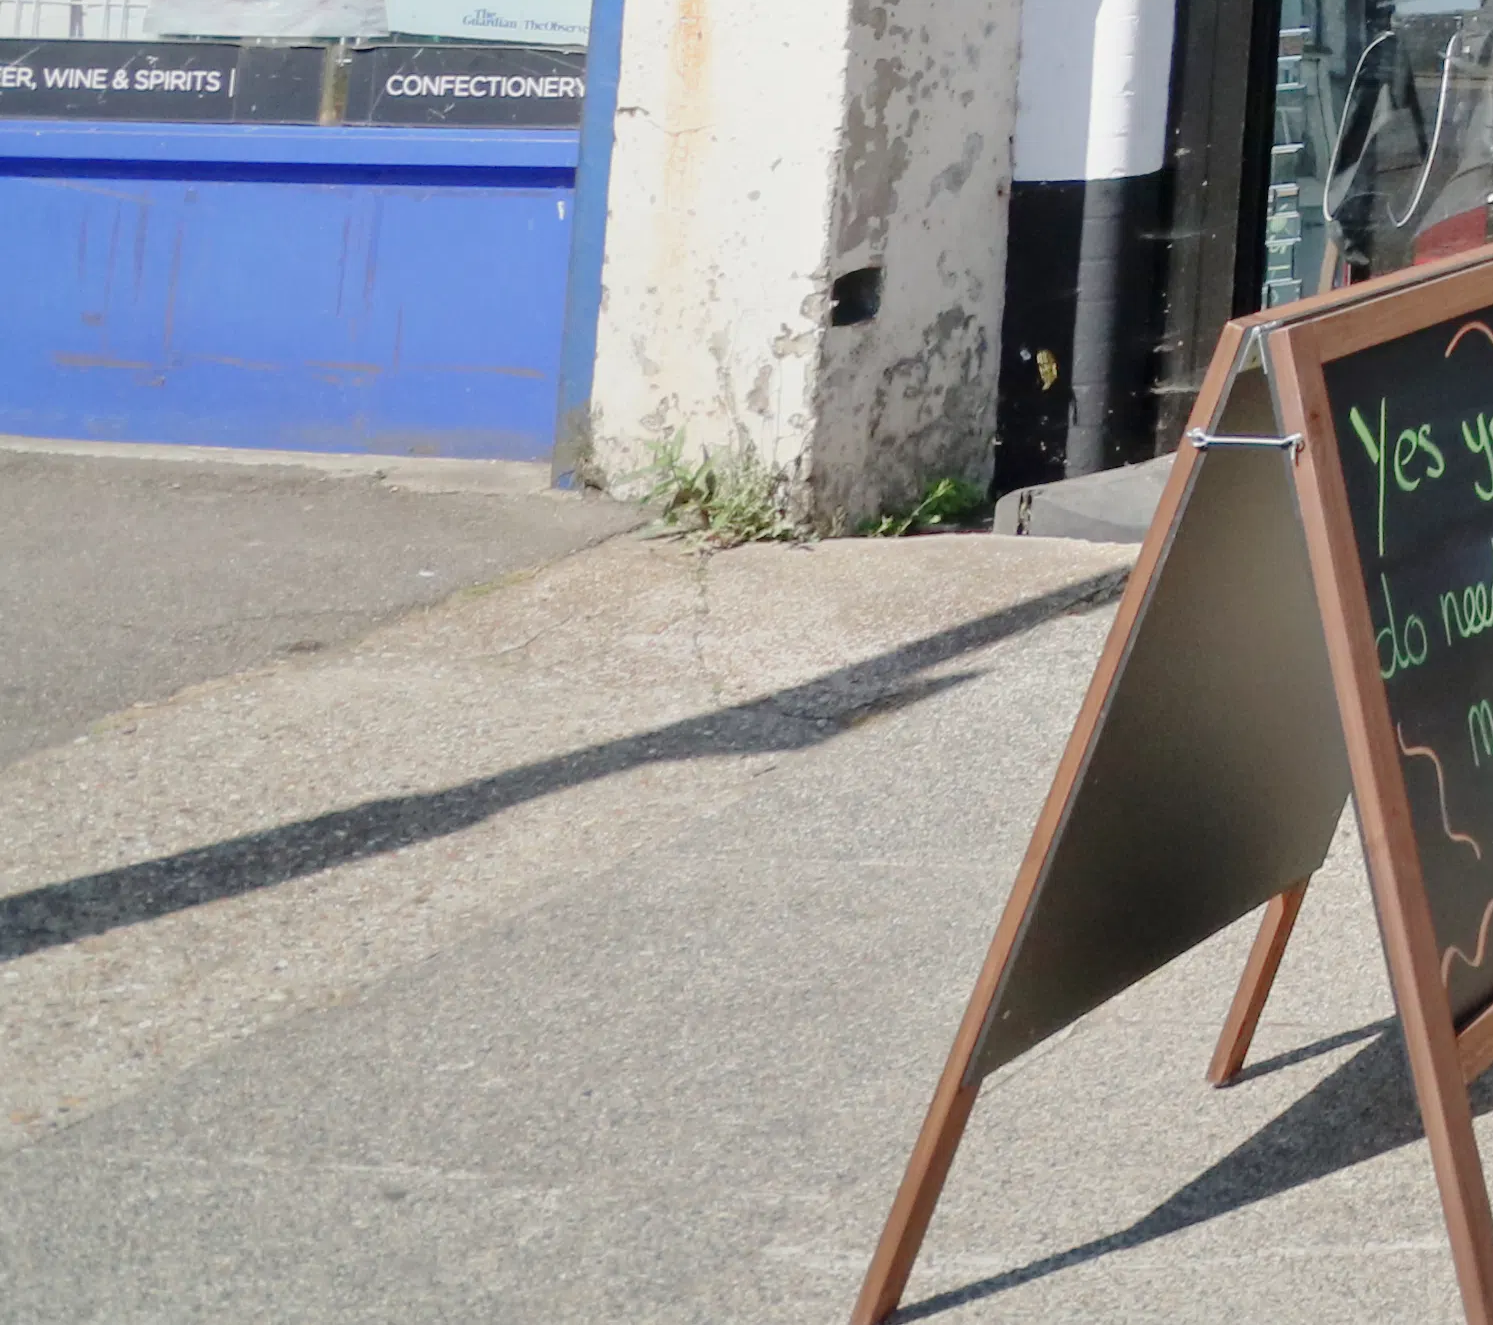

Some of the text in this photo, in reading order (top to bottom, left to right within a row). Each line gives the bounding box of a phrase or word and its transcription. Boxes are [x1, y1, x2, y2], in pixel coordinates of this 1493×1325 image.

[462, 14, 518, 29] Guardian
[474, 8, 498, 19] The
[543, 21, 590, 34] Observe
[0, 66, 38, 90] ER,
[43, 67, 109, 90] WINE
[112, 68, 130, 91] &
[134, 69, 222, 93] SPIRITS
[1349, 396, 1447, 557] Yes
[1374, 572, 1428, 681] do
